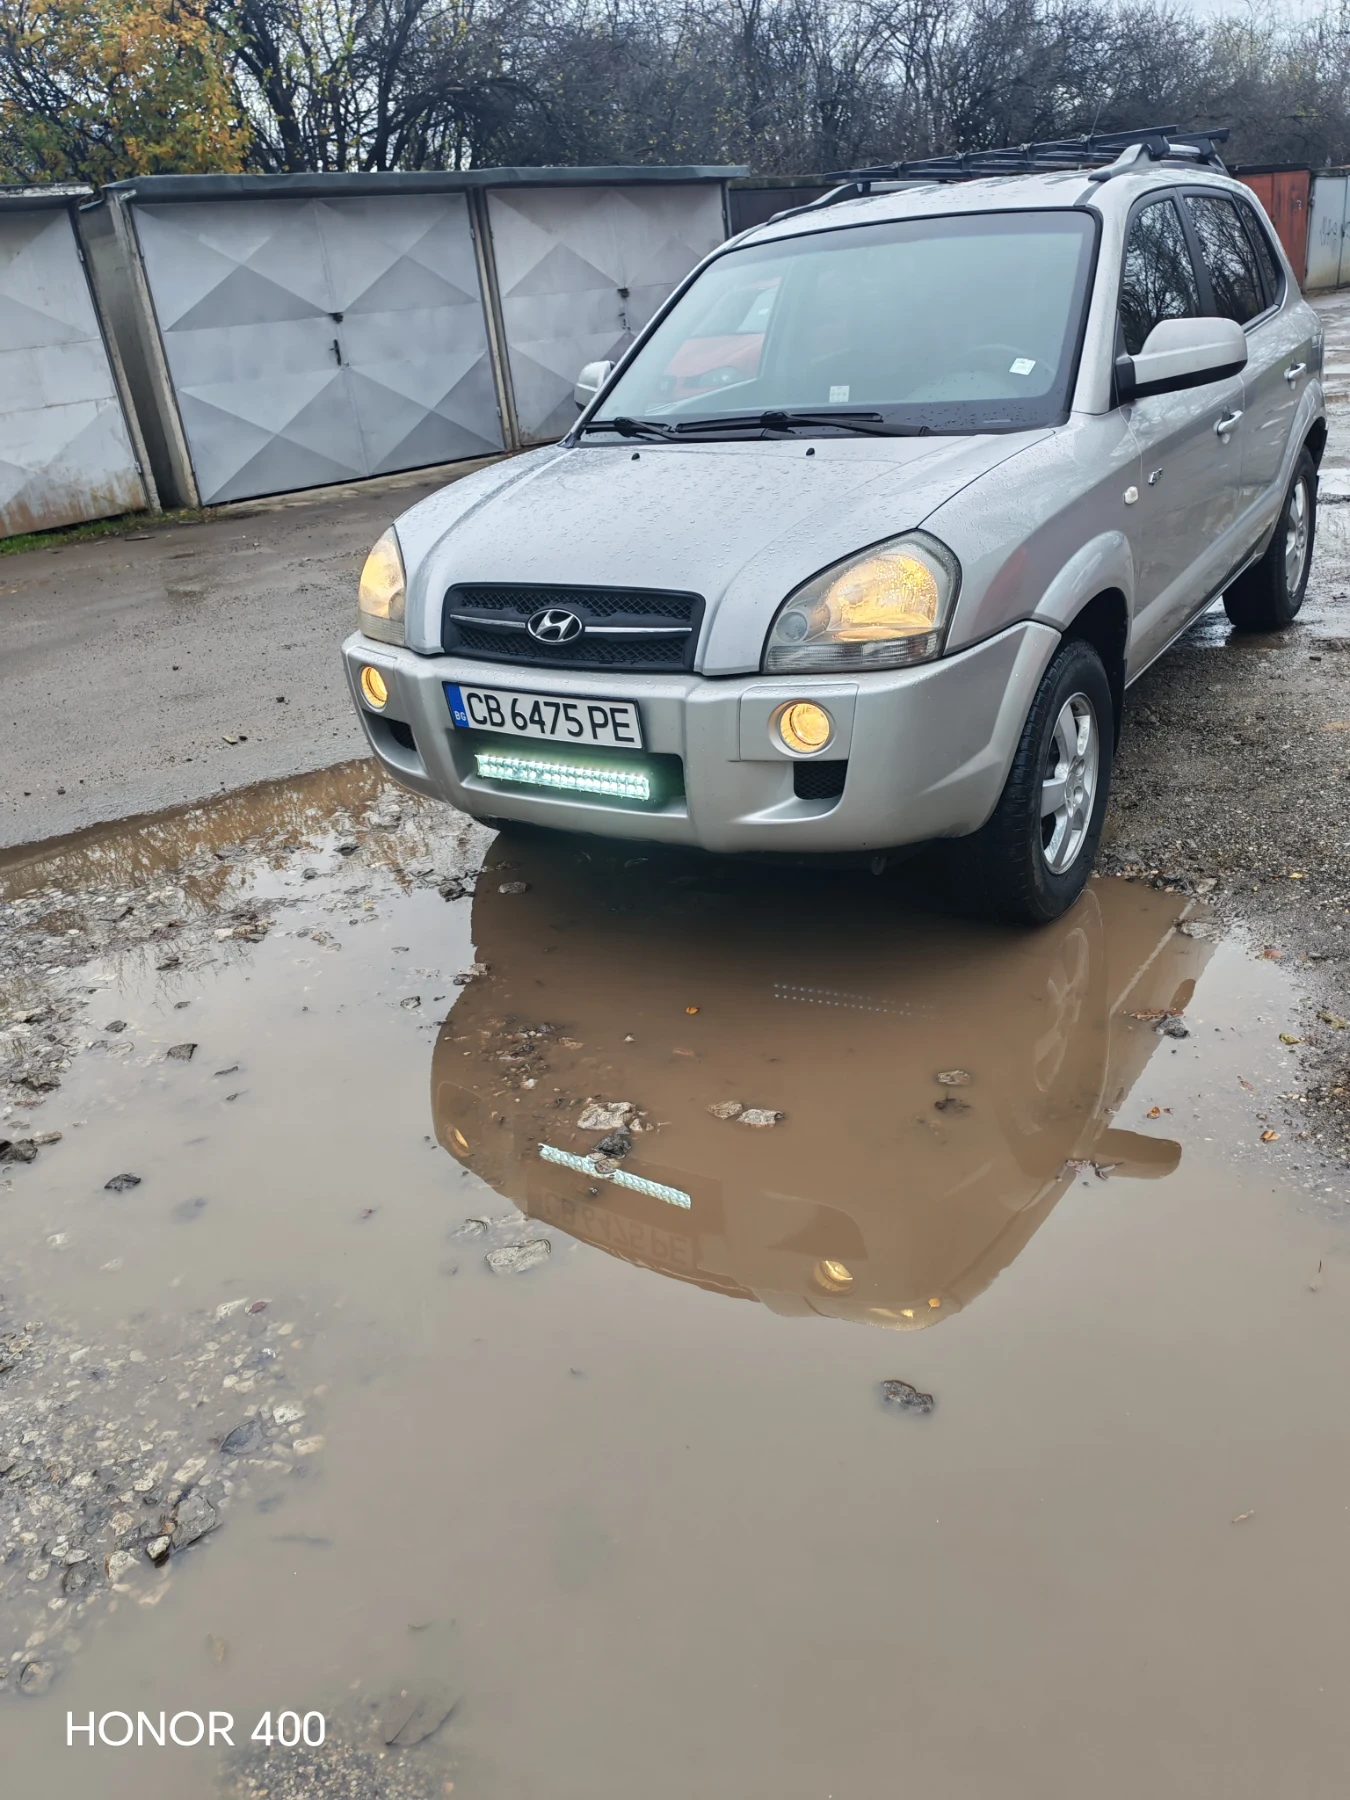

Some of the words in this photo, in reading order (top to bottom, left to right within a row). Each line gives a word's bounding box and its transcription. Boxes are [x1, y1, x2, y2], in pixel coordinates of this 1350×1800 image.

[455, 711, 467, 721] BG
[467, 692, 505, 728] CB
[511, 697, 584, 737] 6475
[587, 705, 635, 743] PE
